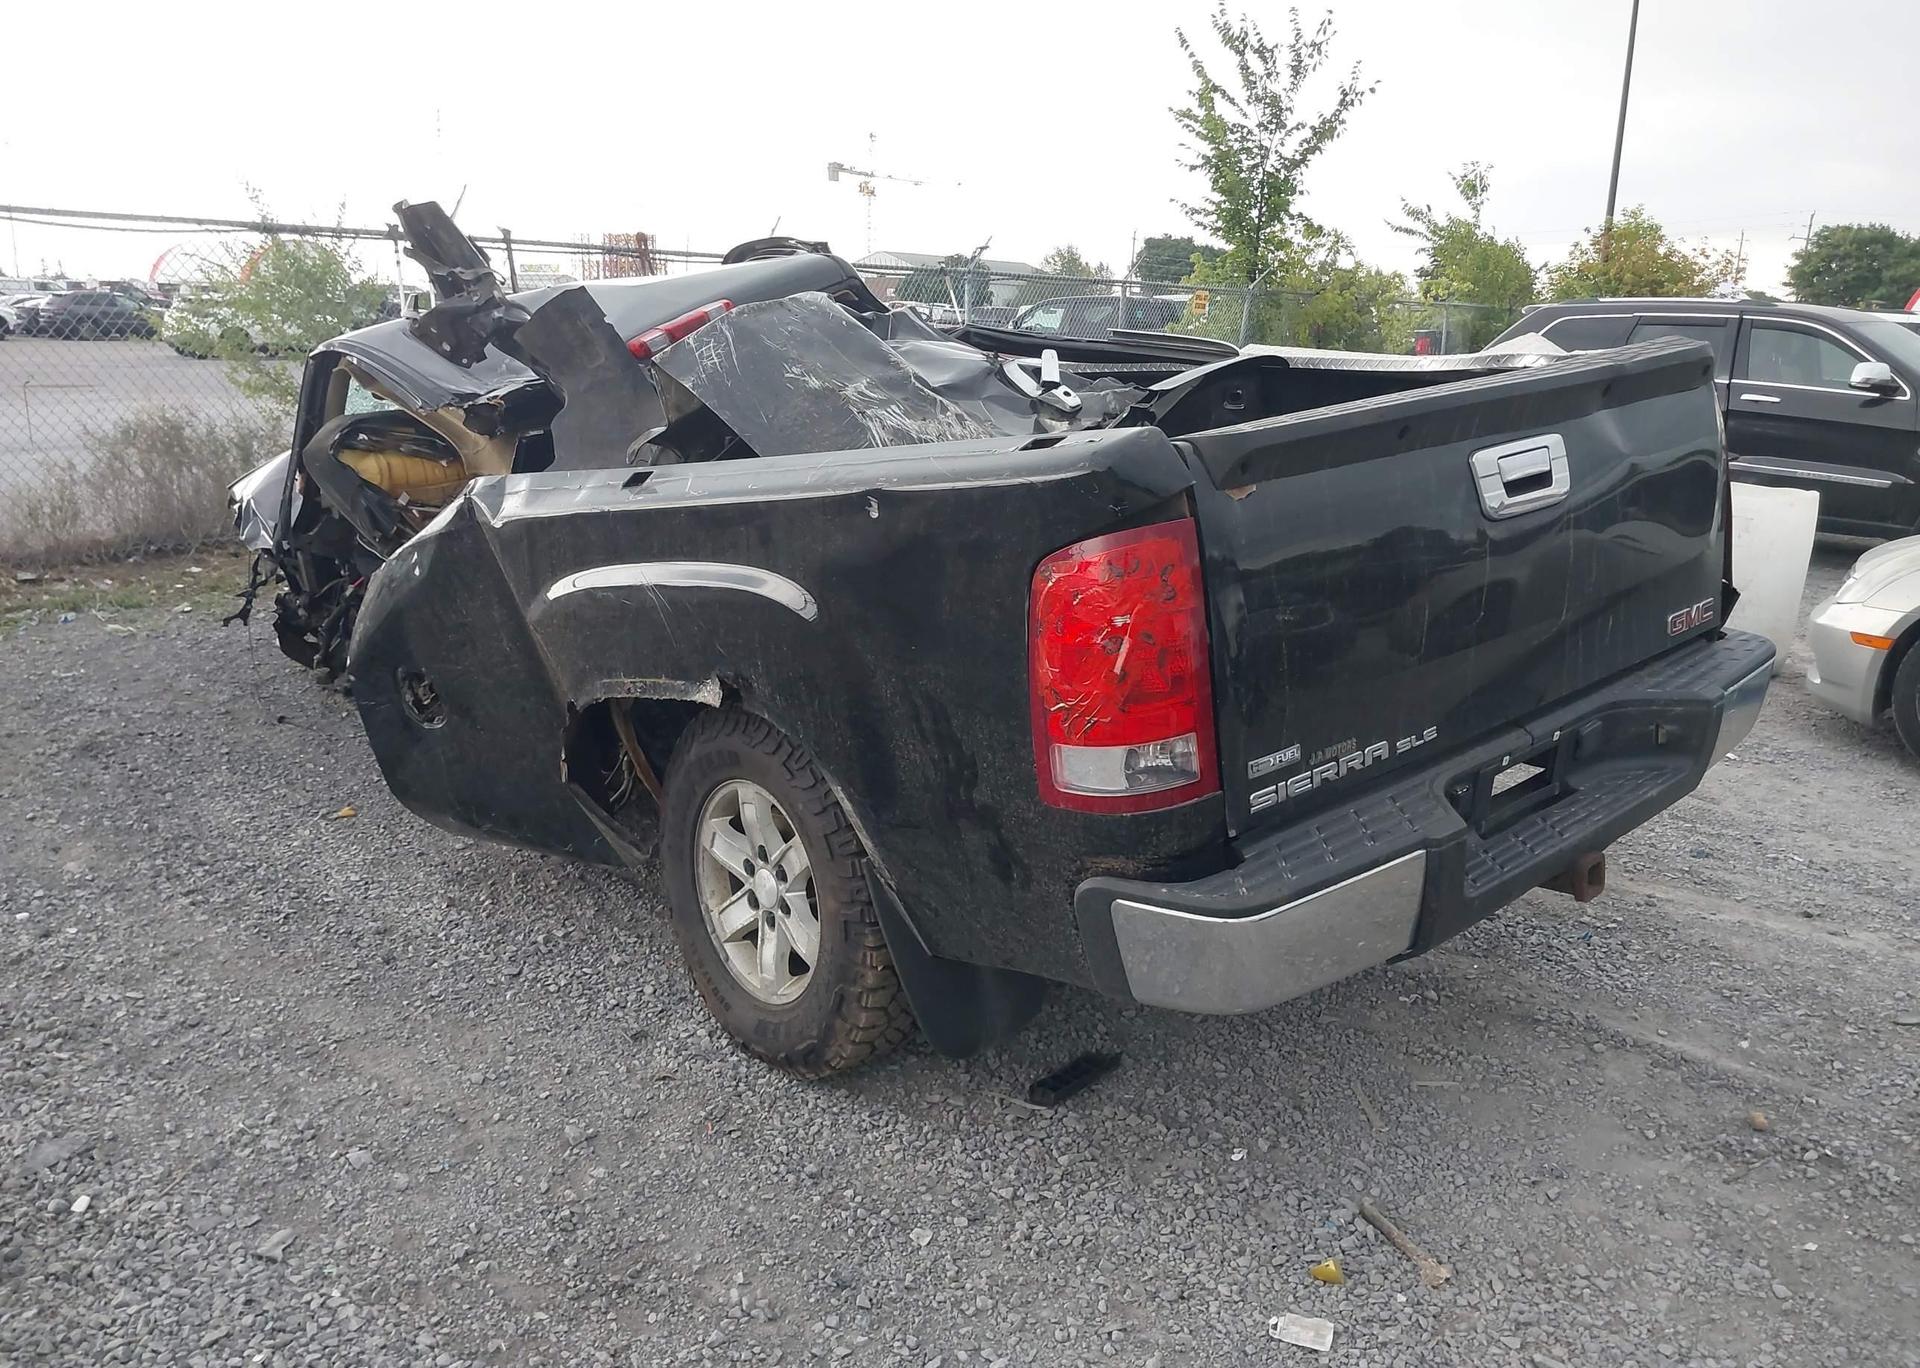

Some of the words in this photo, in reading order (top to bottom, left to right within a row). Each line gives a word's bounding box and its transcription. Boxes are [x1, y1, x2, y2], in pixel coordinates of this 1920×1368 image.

[1667, 597, 1715, 636] GMC
[1276, 748, 1299, 764] FUEL
[1396, 726, 1438, 755] SLE
[1250, 741, 1389, 814] SIERRA
